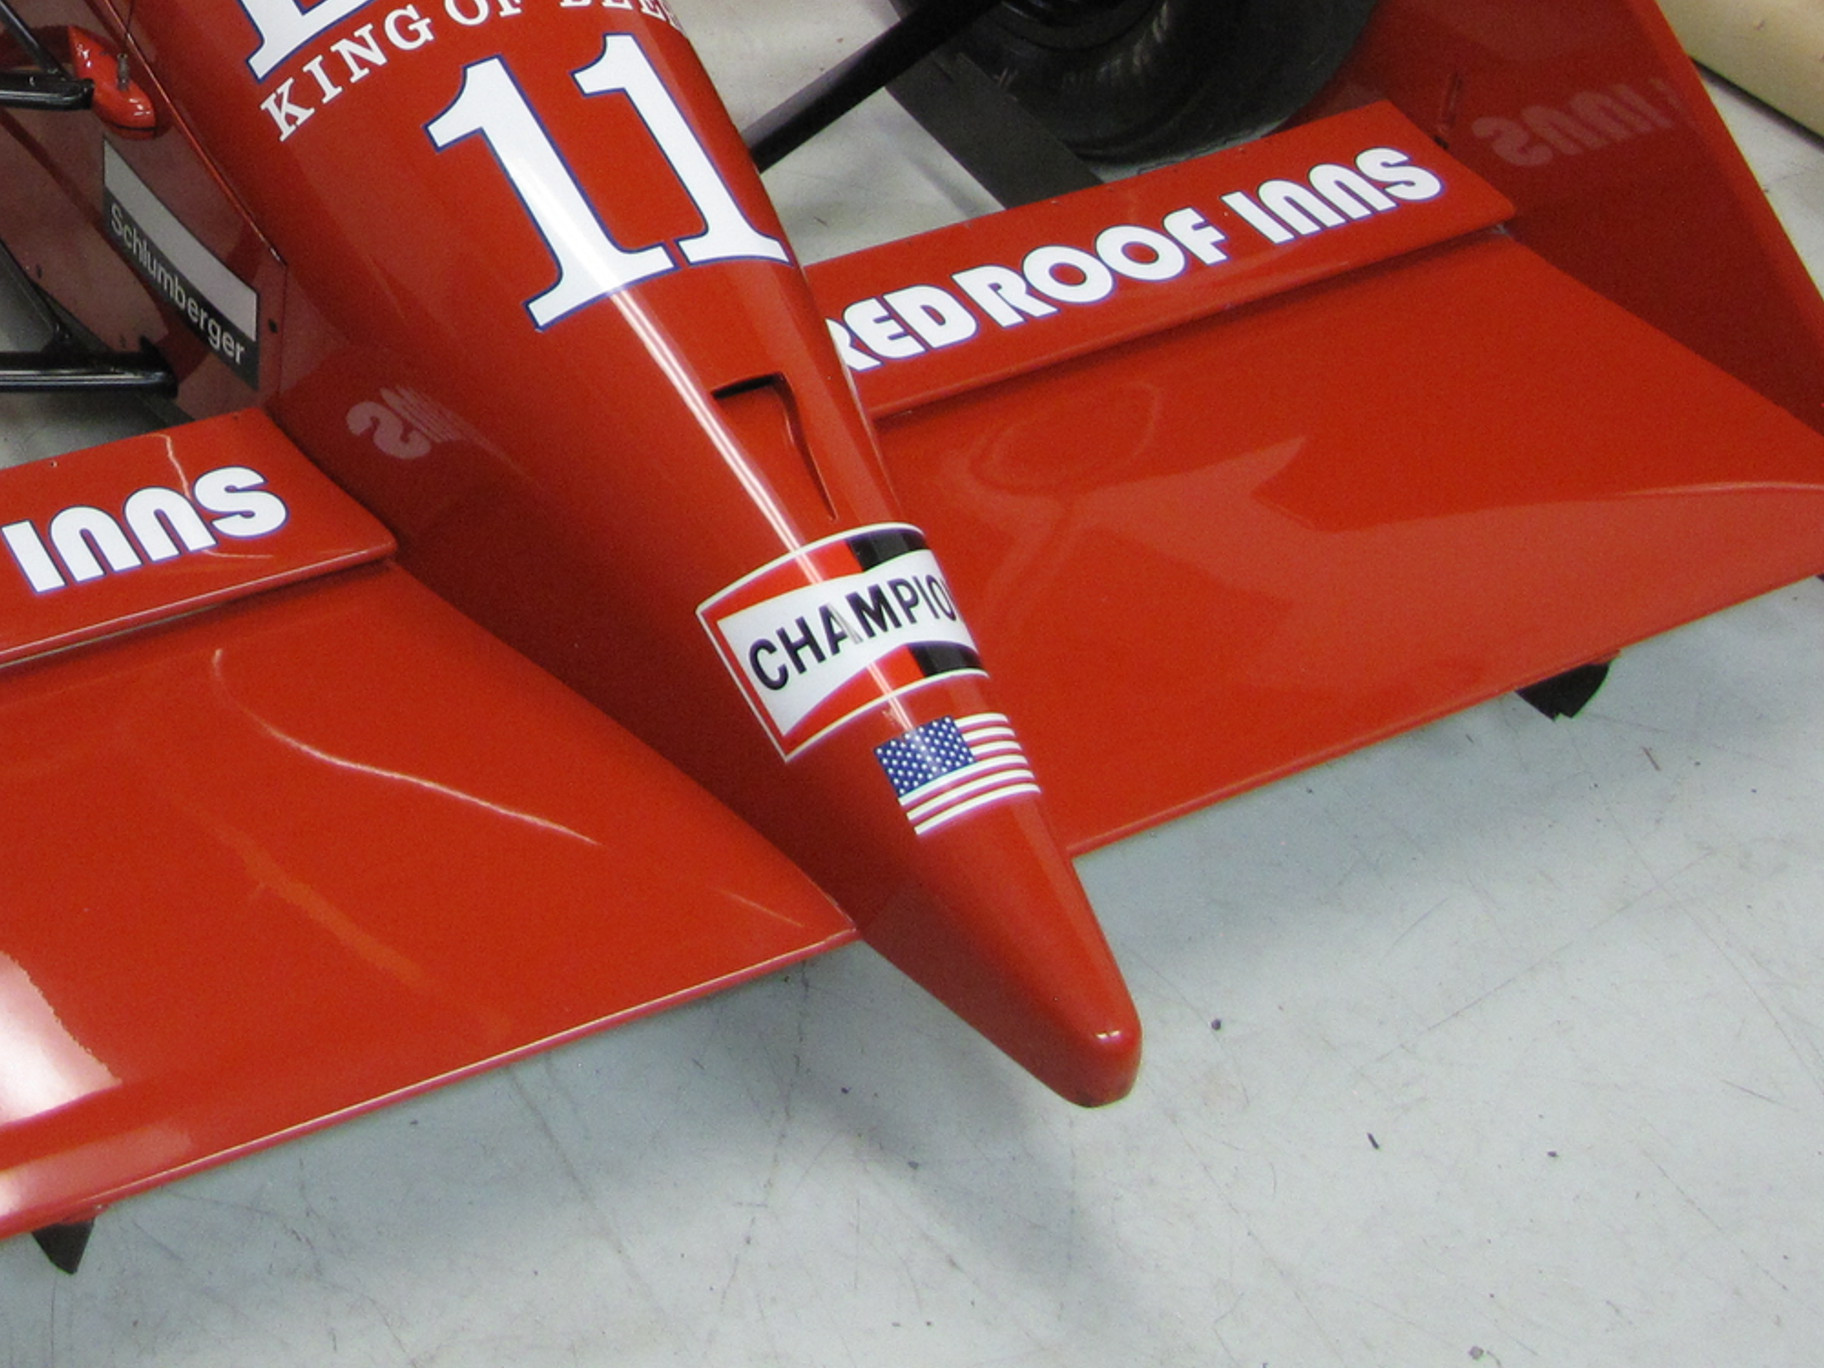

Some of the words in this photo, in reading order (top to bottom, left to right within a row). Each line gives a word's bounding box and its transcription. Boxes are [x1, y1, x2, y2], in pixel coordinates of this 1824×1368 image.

[259, 4, 435, 142] KING
[423, 32, 793, 332] 11
[111, 202, 246, 365] Schlumberger
[951, 205, 1229, 332] ROOF
[748, 573, 957, 691] CHAMPIO
